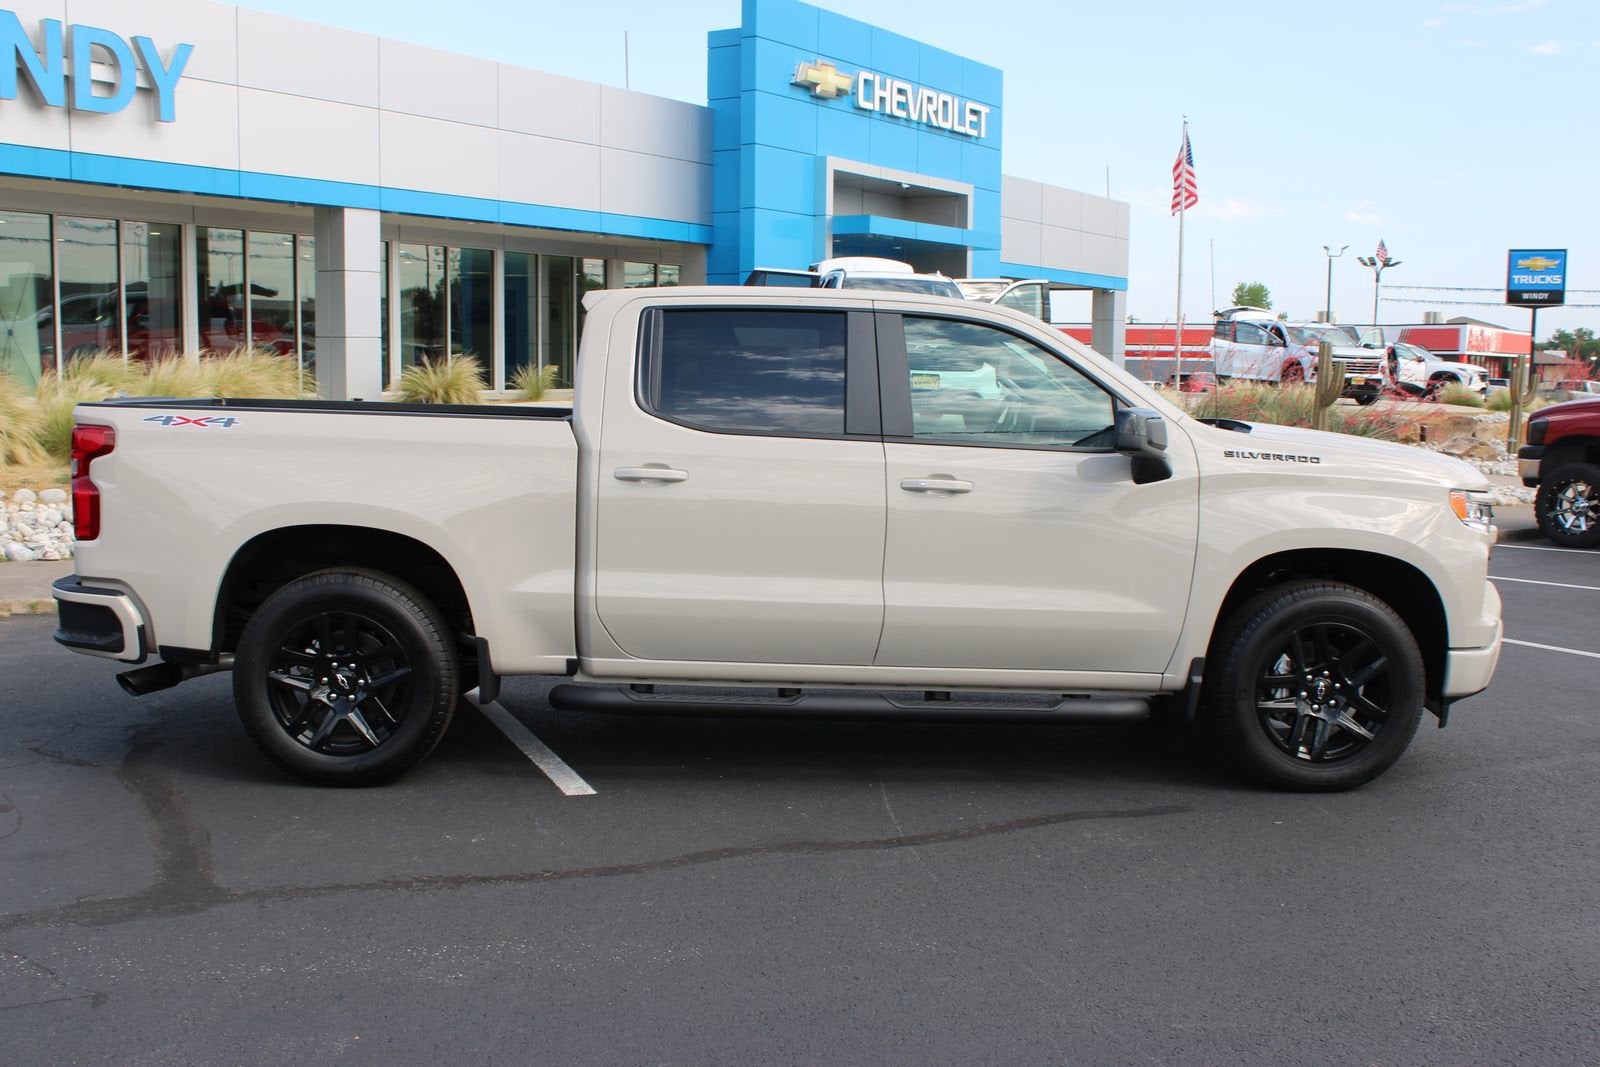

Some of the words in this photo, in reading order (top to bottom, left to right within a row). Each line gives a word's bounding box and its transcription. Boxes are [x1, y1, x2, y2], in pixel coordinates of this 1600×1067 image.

[856, 70, 990, 139] CHEVROLET
[1512, 274, 1563, 285] TRUCKS
[1521, 292, 1550, 300] WINDY
[1223, 450, 1321, 464] SILVERADO
